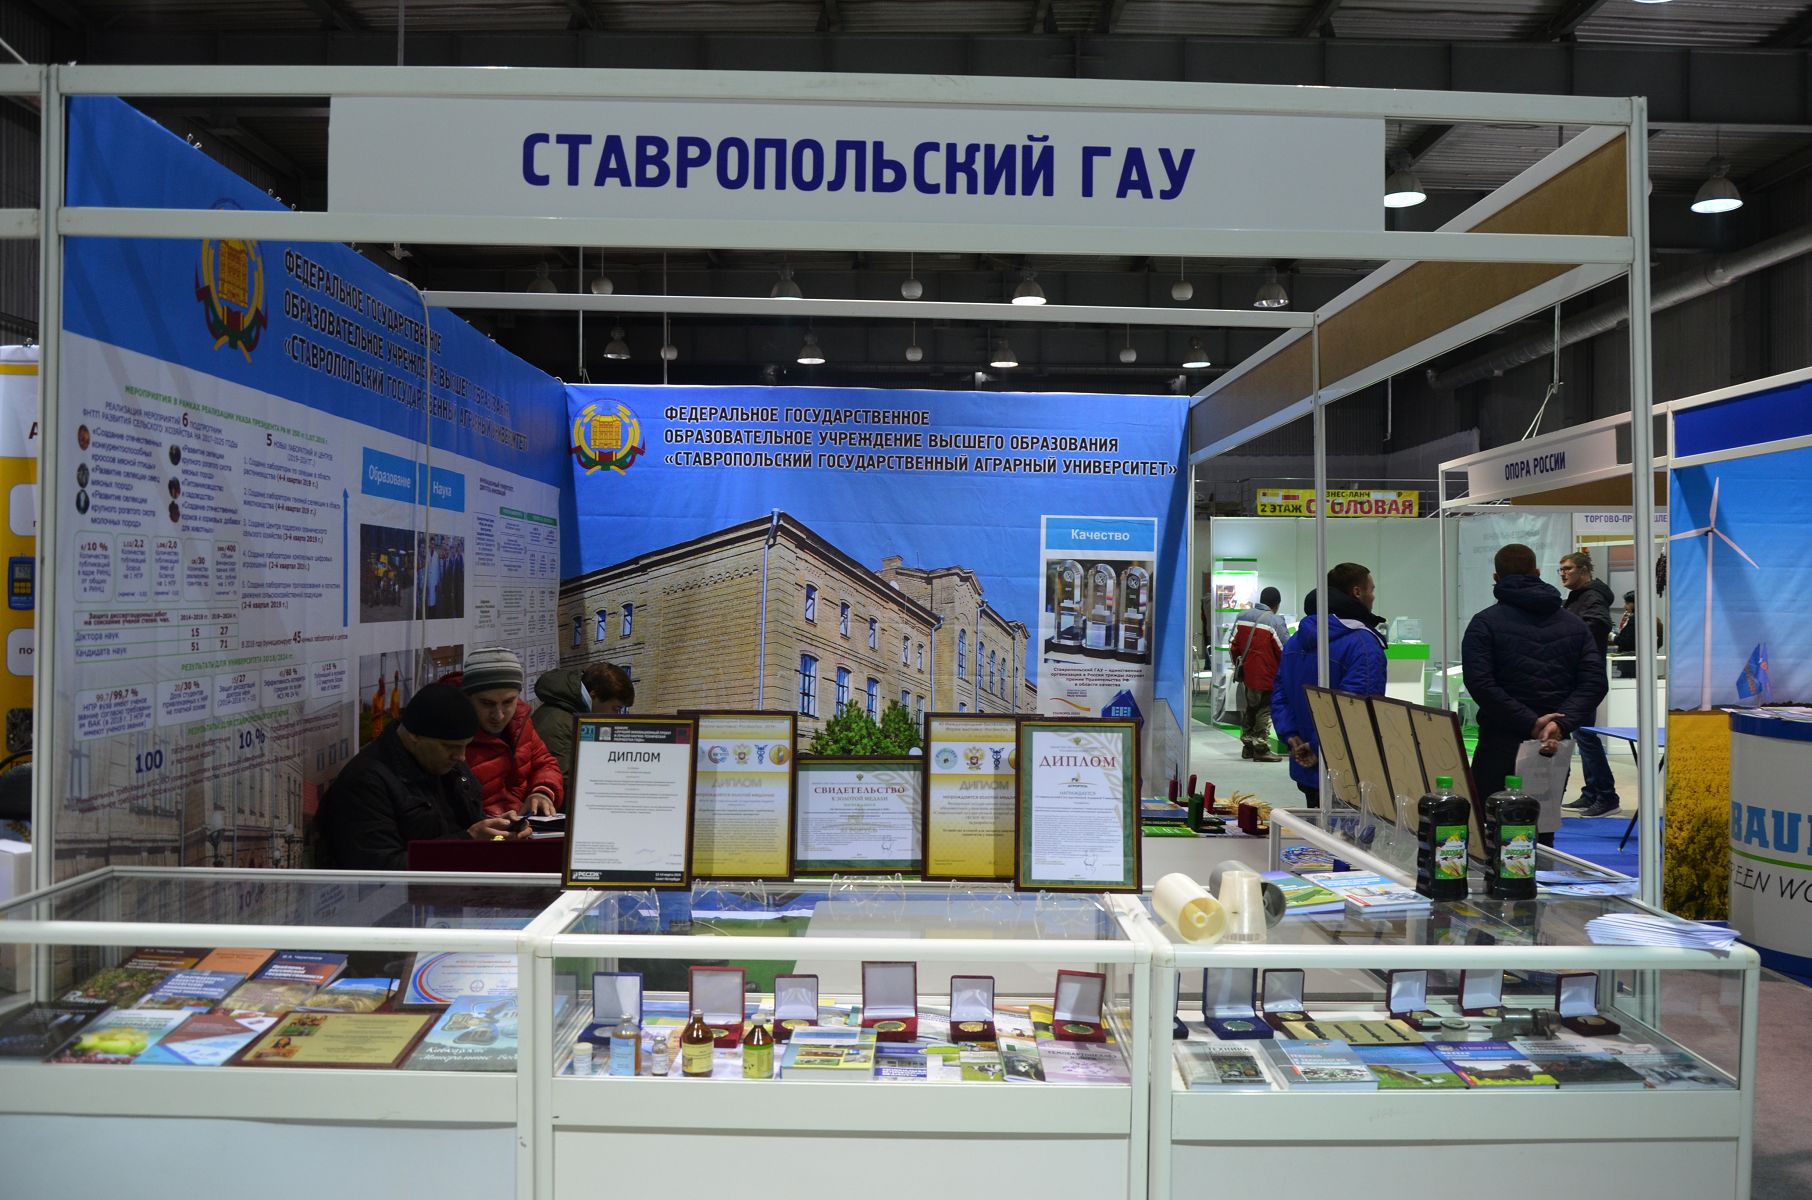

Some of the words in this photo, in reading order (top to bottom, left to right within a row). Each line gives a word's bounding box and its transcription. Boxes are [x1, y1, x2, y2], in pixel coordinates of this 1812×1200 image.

[522, 132, 1055, 197] СТАВРОПОЛЬСКИЙ
[1081, 145, 1196, 201] ГАУ
[285, 248, 363, 314] ФЕДЕРАЛЬНОЕ
[285, 290, 384, 359] ОБРАЗОВАТЕЛЬНОЕ
[387, 342, 438, 384] УЧРЕЖДЕЕ
[284, 335, 384, 394] «СТАВРОПОЛЬСКИЙ
[182, 412, 189, 427] 6
[664, 406, 779, 423] ФЕДЕРАЛЬНОЕ
[784, 408, 930, 426] ГОСУДАРСТВЕННОЕ
[266, 433, 272, 446] 5
[664, 428, 813, 446] ОБРАЗОВАТЕЛЬНОЕ
[818, 431, 923, 448] УЧРЕЖДЕНИЕ
[928, 434, 1004, 450] ВЫСШЕГО
[1010, 435, 1118, 452] ОБРАЗОВАНИЯ
[664, 450, 813, 469] «СТАВРОПОЛЬСКИЙ
[818, 453, 968, 471] ГОСУДАРСТВЕННЫЙ
[973, 455, 1057, 473] АГРАРНЫЙ
[1062, 459, 1178, 476] УНИВЕРСИТЕТ»
[1504, 459, 1531, 481] ОПОРА
[1533, 452, 1566, 475] РОССИИ
[368, 464, 411, 489] Образование
[432, 480, 452, 498] Наука
[1260, 504, 1267, 513] 2
[1269, 504, 1302, 513] ЭТАЖ
[1071, 528, 1130, 541] Качество
[190, 627, 200, 637] 15
[219, 626, 229, 635] 27
[292, 631, 301, 644] 45
[190, 641, 200, 651] 51
[219, 639, 228, 649] 71
[239, 729, 252, 750] 10
[135, 749, 163, 774] 100
[608, 750, 661, 763] ДИПЛОМ
[1039, 755, 1116, 768] ДИПЛОМ
[711, 778, 762, 788] ДИПЛОМ
[814, 786, 905, 795] СВИДЕТЕЛЬСТВО
[959, 780, 1009, 790] ДИПЛОМ
[1731, 800, 1812, 857] BAU
[1730, 862, 1771, 894] EEN
